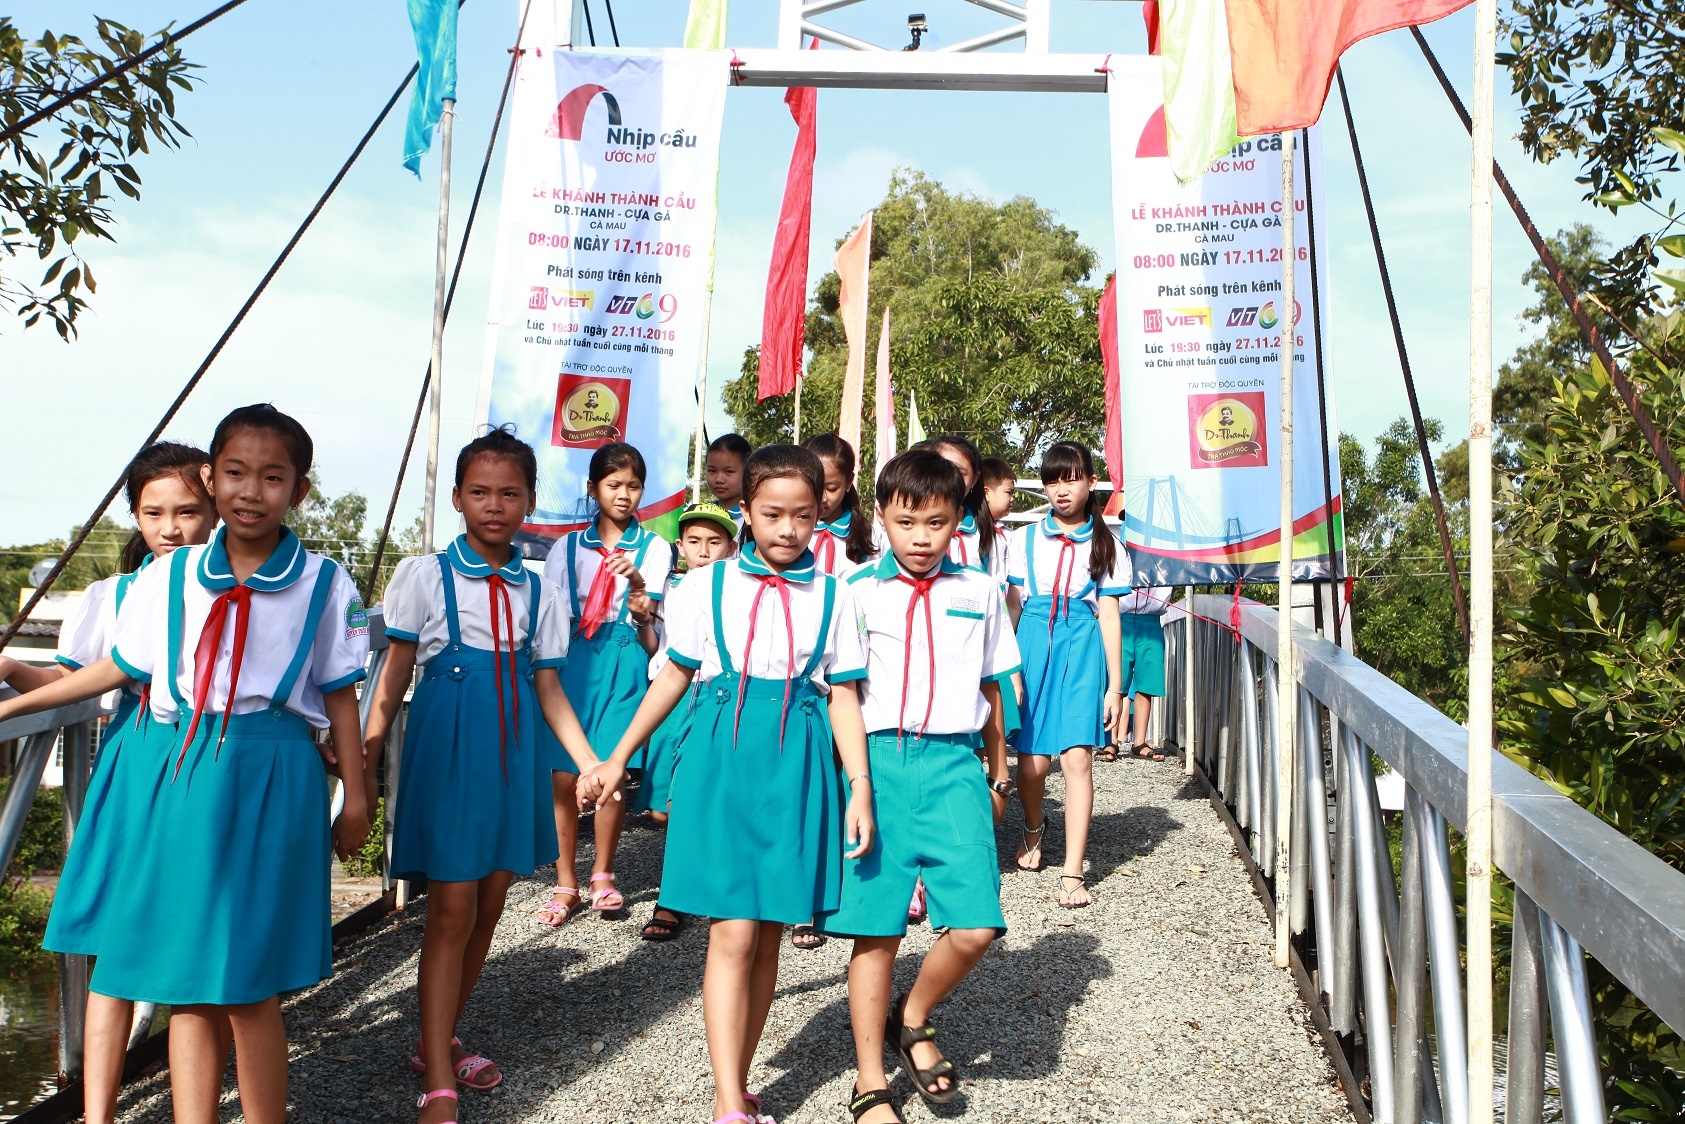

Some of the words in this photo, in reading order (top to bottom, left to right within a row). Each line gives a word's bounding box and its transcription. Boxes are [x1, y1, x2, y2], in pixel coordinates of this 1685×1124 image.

[607, 127, 655, 149] Nhịp
[660, 129, 697, 148] cầu
[1257, 133, 1297, 152] cầ
[605, 151, 633, 163] ƯỚC
[636, 152, 656, 163] MƠ
[1233, 159, 1255, 171] MƠ
[552, 188, 605, 204] KHÁNH
[610, 191, 659, 207] THÀNH
[664, 191, 696, 209] CẦU
[554, 205, 615, 218] DR.THANH
[625, 209, 650, 224] CỰA
[654, 211, 671, 221] GÀ
[1132, 203, 1146, 220] LỄ
[1152, 204, 1207, 219] KHÁNH
[1212, 201, 1265, 216] THÀNH
[1270, 200, 1305, 213] CU
[590, 221, 603, 230] CÀ
[605, 222, 626, 230] MAU
[1156, 222, 1219, 233] DR.THANH
[1230, 218, 1258, 232] CỰA
[1262, 215, 1282, 227] GÀ
[529, 232, 569, 249] 08:00
[574, 235, 610, 251] NGÀY
[614, 239, 690, 258] 17.11.2016
[1194, 235, 1209, 243] CÀ
[1211, 234, 1234, 243] MAU
[1134, 254, 1175, 268] 08:00
[1180, 250, 1218, 266] NGÀY
[1224, 247, 1307, 265] 17.11.26
[547, 265, 574, 278] Phát
[578, 267, 604, 281] sóng
[608, 269, 630, 282] trên
[635, 271, 662, 284] kênh
[1158, 284, 1185, 297] Phát
[1190, 283, 1219, 297] sóng
[1222, 281, 1248, 294] trên
[1252, 280, 1281, 293] kênh
[659, 293, 678, 323] 9
[527, 319, 544, 330] Lúc
[552, 322, 578, 333] 19:30
[584, 324, 607, 338] ngày
[611, 326, 675, 341] 27.11.2016
[536, 336, 552, 345] Chủ
[554, 337, 571, 347] nhật
[573, 338, 591, 348] tuần
[593, 340, 610, 350] cuối
[613, 341, 632, 352] cùng
[634, 343, 648, 353] mỗi
[651, 345, 674, 356] tháng
[1145, 343, 1164, 354] Lúc
[1171, 341, 1200, 353] 19:30
[1206, 340, 1231, 354] ngày
[1236, 335, 1304, 350] 27.11.26
[561, 361, 571, 369] TÀI
[573, 362, 588, 371] TRỢ
[590, 364, 605, 373] ĐỘC
[607, 364, 632, 374] QUYỀN
[1145, 360, 1154, 368] và
[1157, 358, 1173, 367] Chủ
[1176, 357, 1194, 368] nhật
[1197, 357, 1216, 366] tuần
[1219, 356, 1237, 365] cuối
[1240, 355, 1260, 365] cùng
[1263, 353, 1278, 363] mỗi
[1219, 380, 1235, 389] ĐỘC
[1238, 379, 1264, 387] QUYỀN
